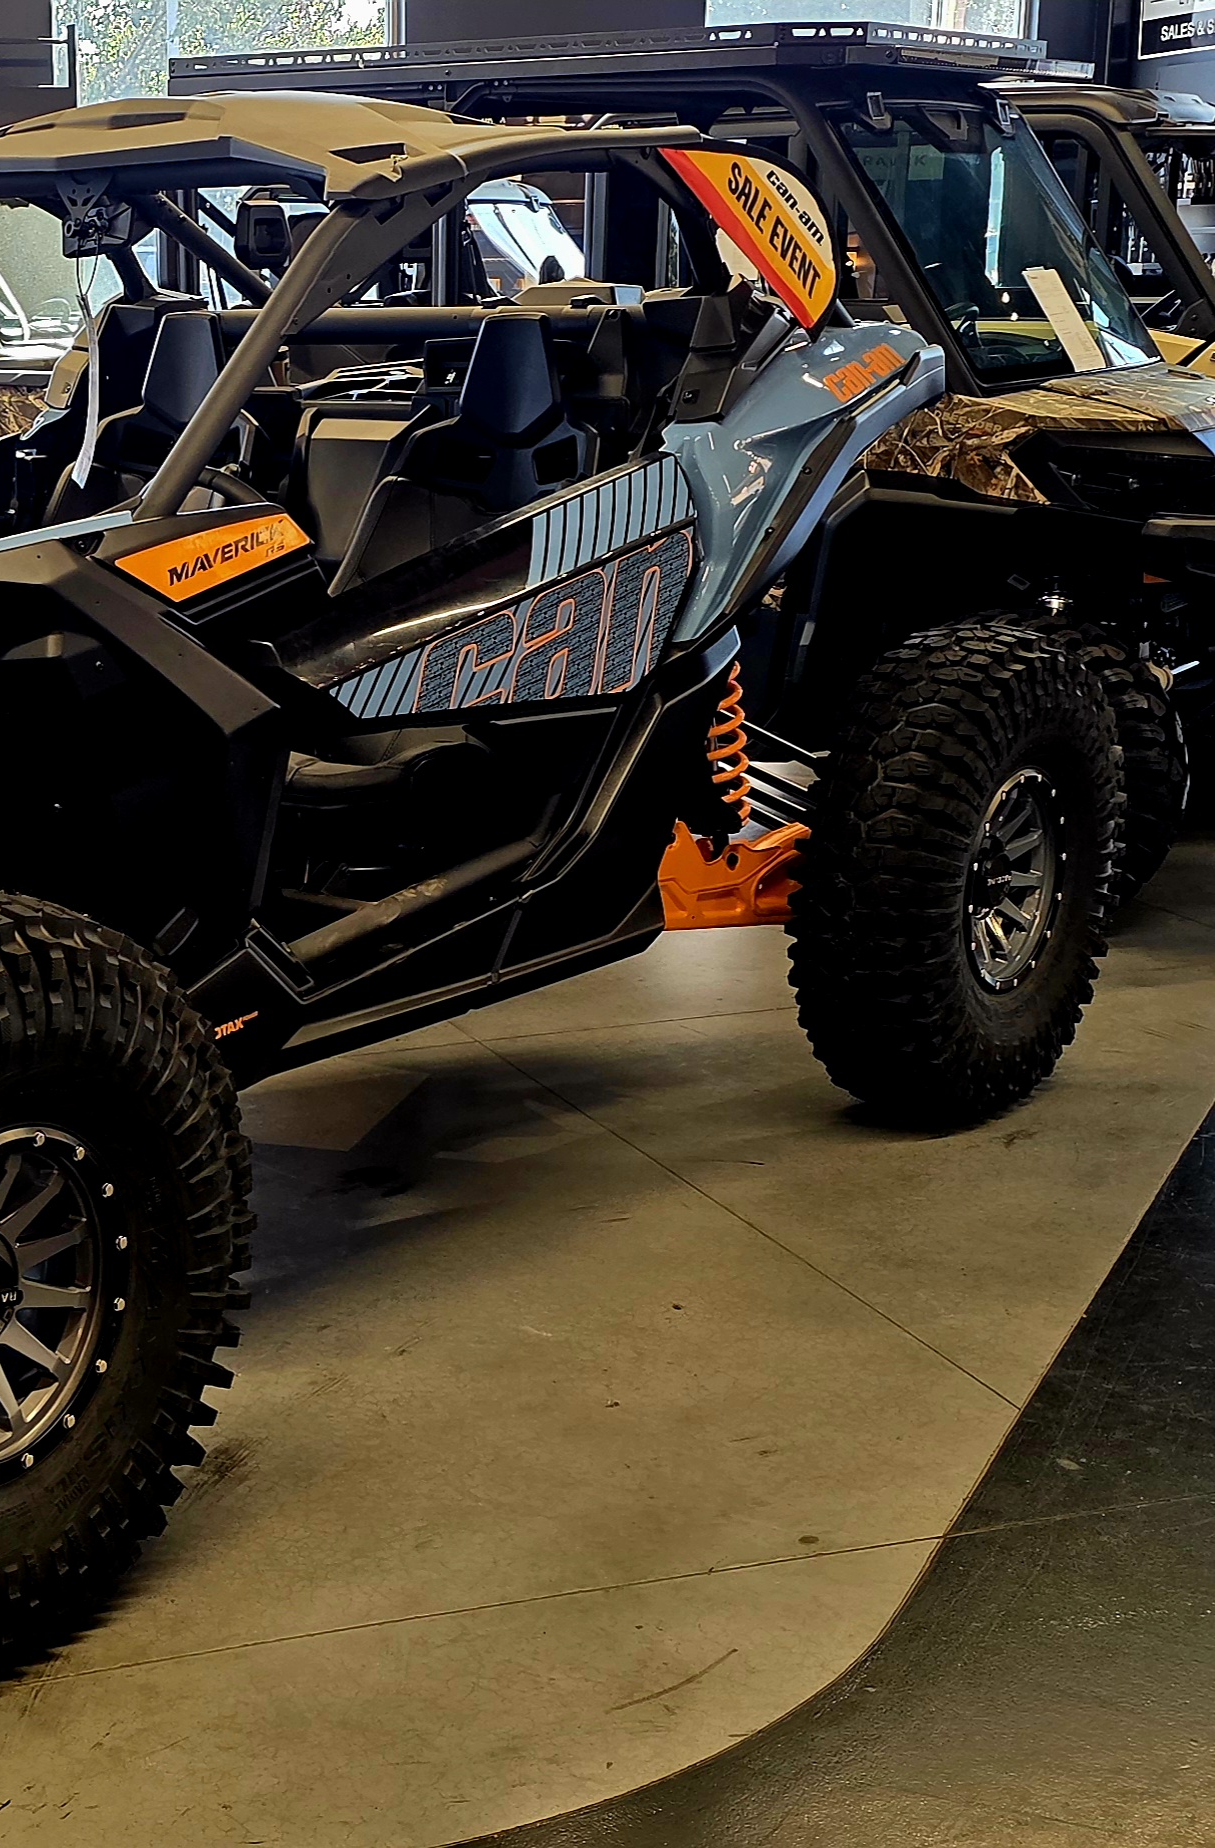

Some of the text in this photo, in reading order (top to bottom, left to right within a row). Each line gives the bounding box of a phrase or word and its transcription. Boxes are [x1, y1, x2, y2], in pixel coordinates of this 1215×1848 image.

[1160, 18, 1215, 41] SALES & S
[727, 161, 821, 300] SALE EVENT
[765, 170, 826, 247] can-am
[822, 343, 909, 403] can-am
[167, 518, 284, 587] MAVERICK
